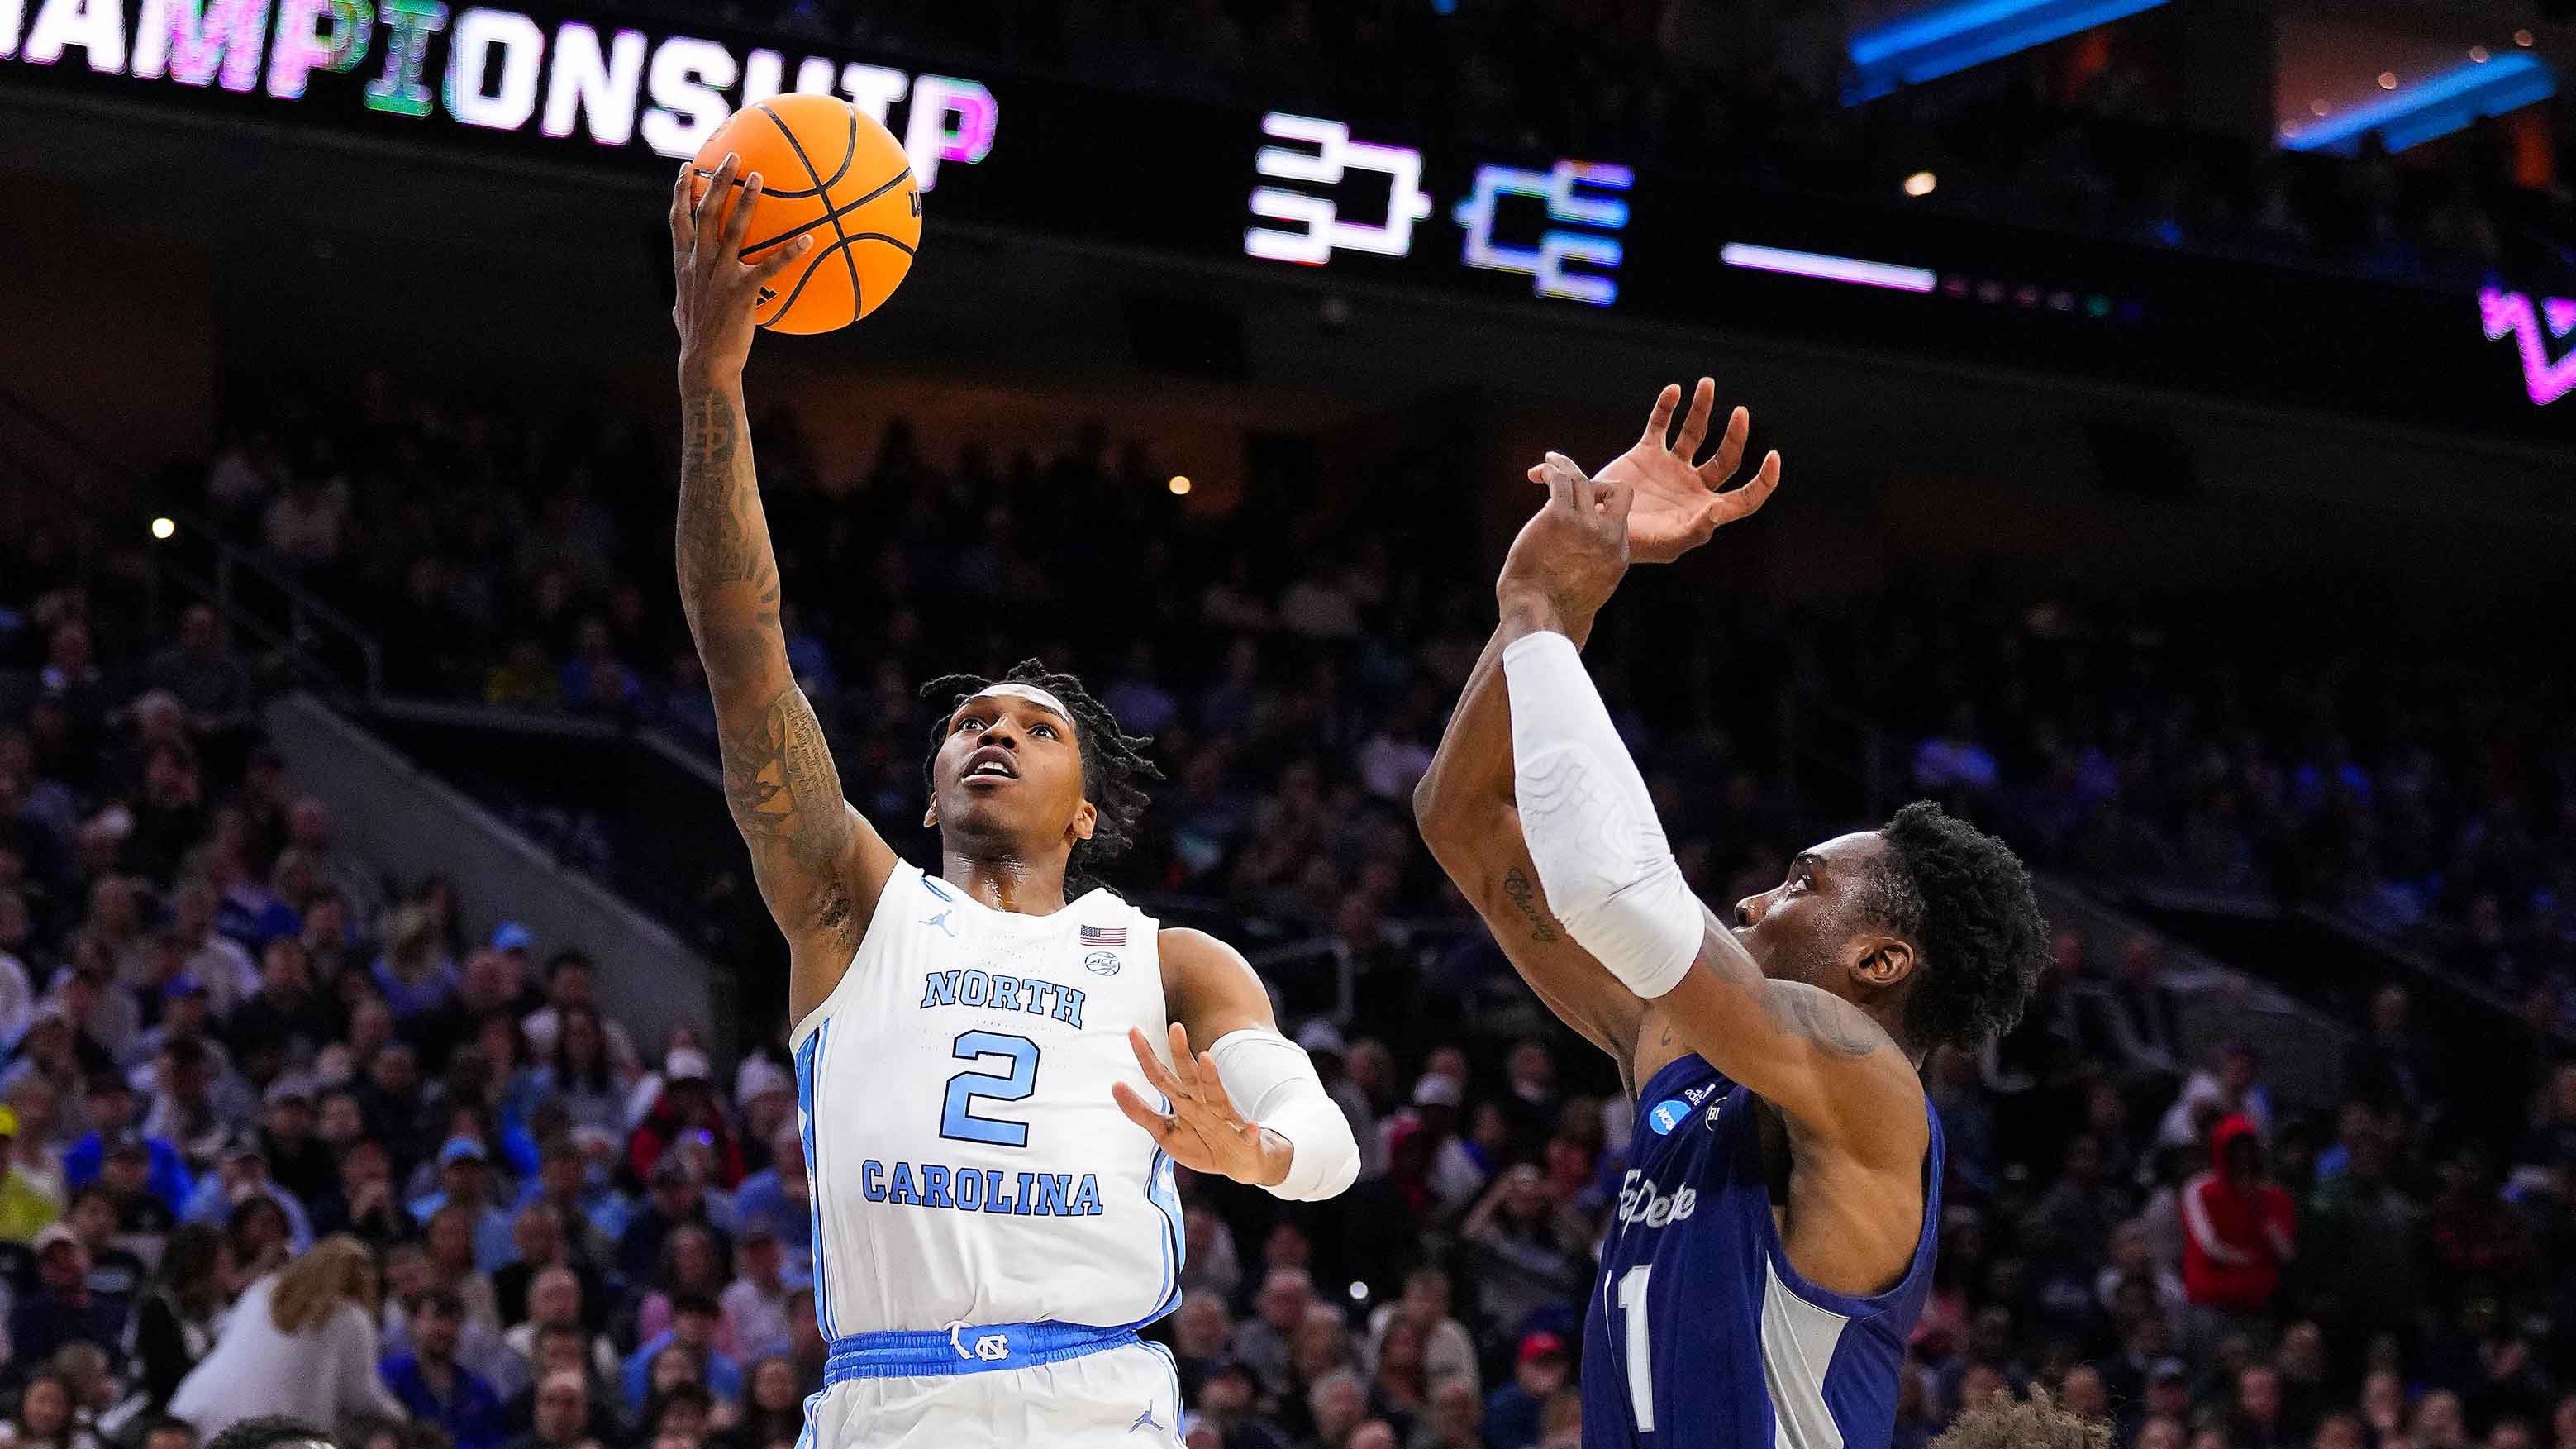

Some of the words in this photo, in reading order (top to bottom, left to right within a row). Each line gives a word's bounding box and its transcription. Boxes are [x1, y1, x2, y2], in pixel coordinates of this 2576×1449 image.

[0, 0, 998, 193] AMPIONSP
[920, 970, 1085, 1029] NORTH
[939, 1029, 1041, 1147] 2
[861, 1160, 1103, 1216] CAROLINA
[1603, 1264, 1655, 1433] 1
